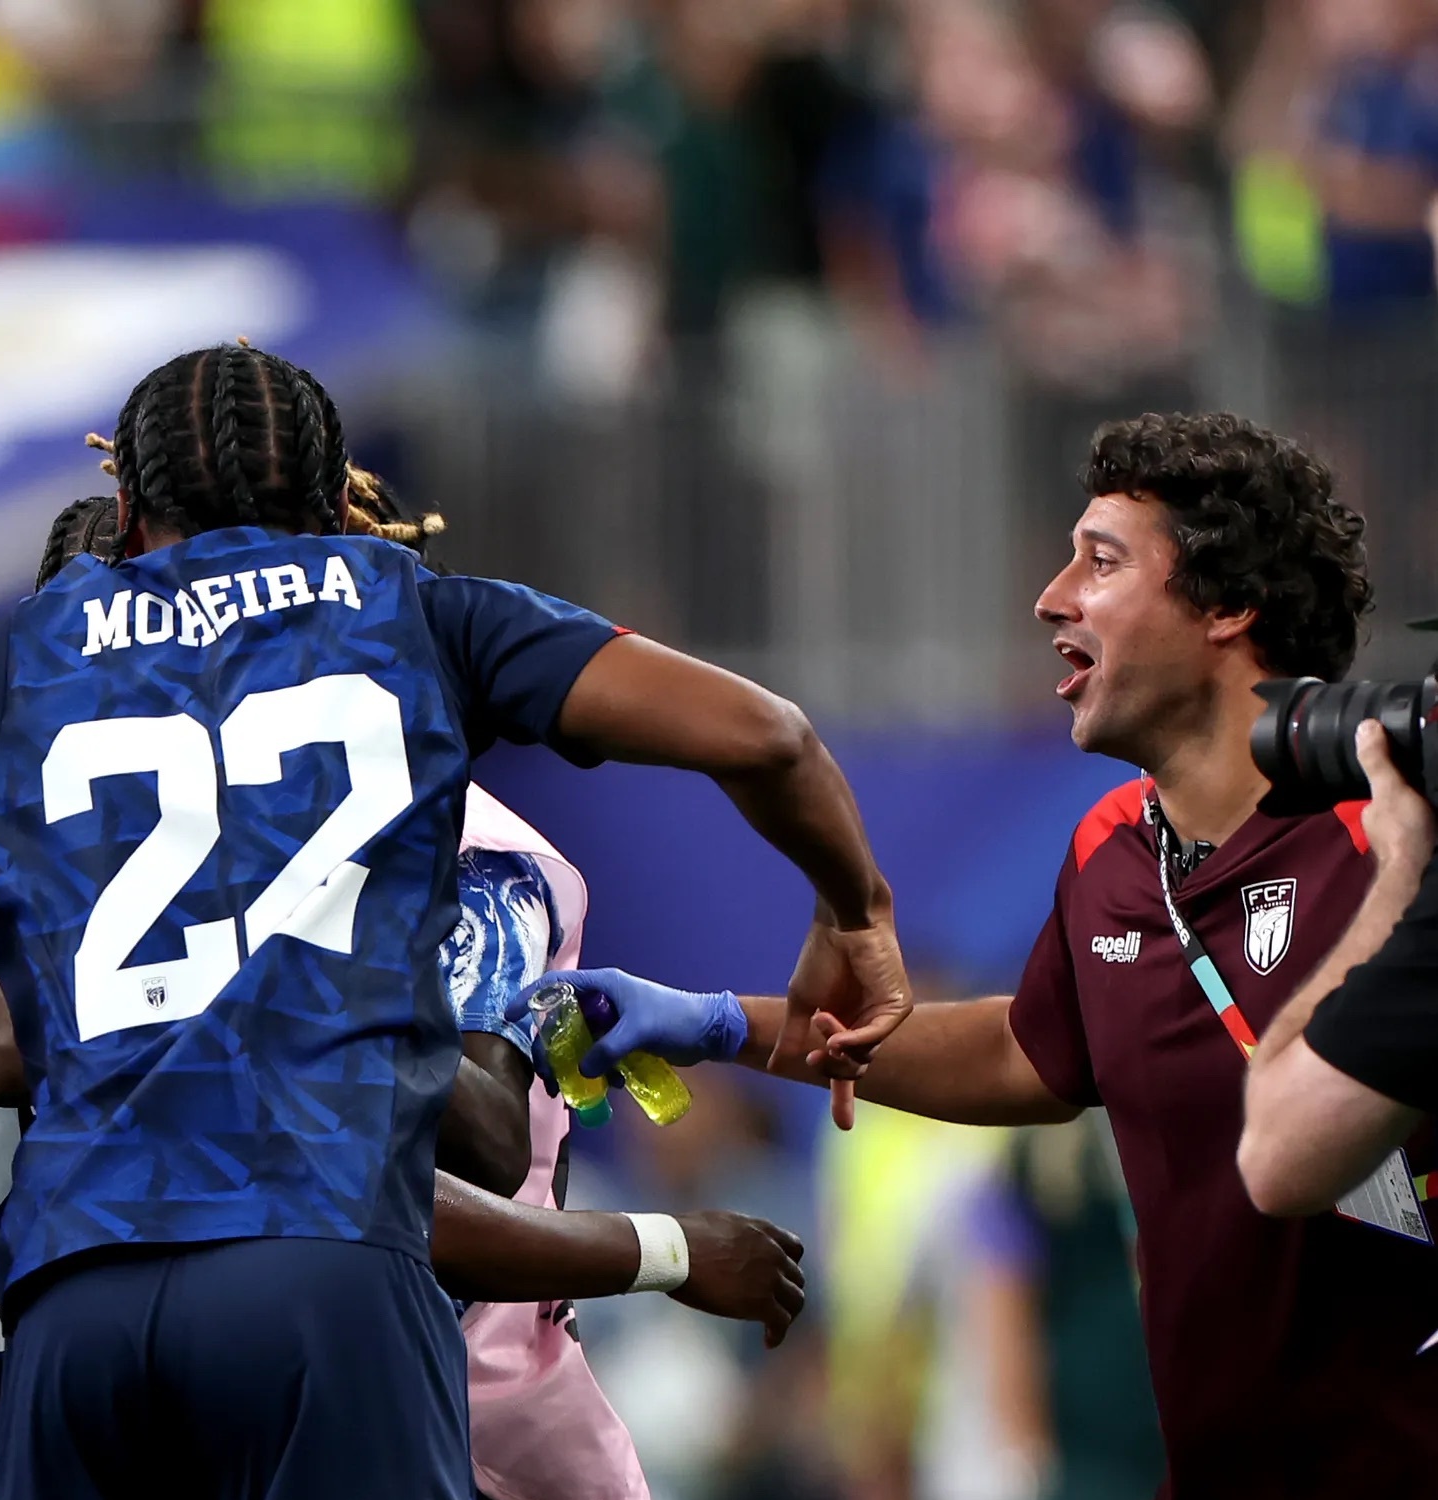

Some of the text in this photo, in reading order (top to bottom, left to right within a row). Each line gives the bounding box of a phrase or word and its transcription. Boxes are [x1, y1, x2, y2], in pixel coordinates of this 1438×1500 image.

[41, 673, 414, 1043] 22
[1248, 884, 1292, 906] FCF
[1091, 931, 1142, 960] capelli
[1106, 953, 1139, 963] SPORT
